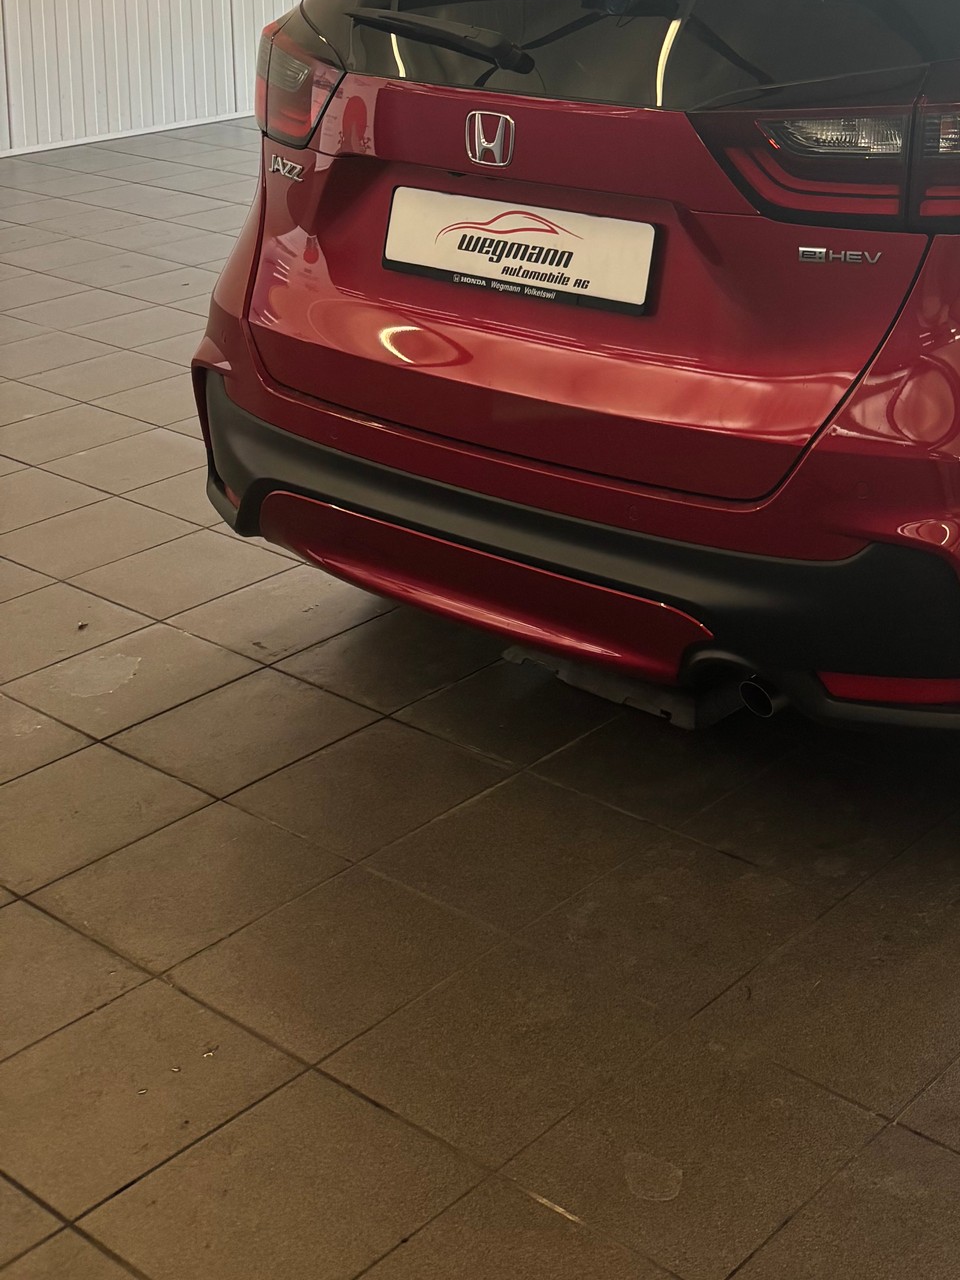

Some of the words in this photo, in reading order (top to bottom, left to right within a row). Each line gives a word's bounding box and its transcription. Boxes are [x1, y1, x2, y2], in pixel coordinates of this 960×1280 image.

[269, 154, 304, 182] JAZZ
[457, 233, 574, 269] wegmann
[460, 275, 487, 287] HONDA
[490, 280, 521, 293] Wegmann
[573, 278, 591, 290] AG
